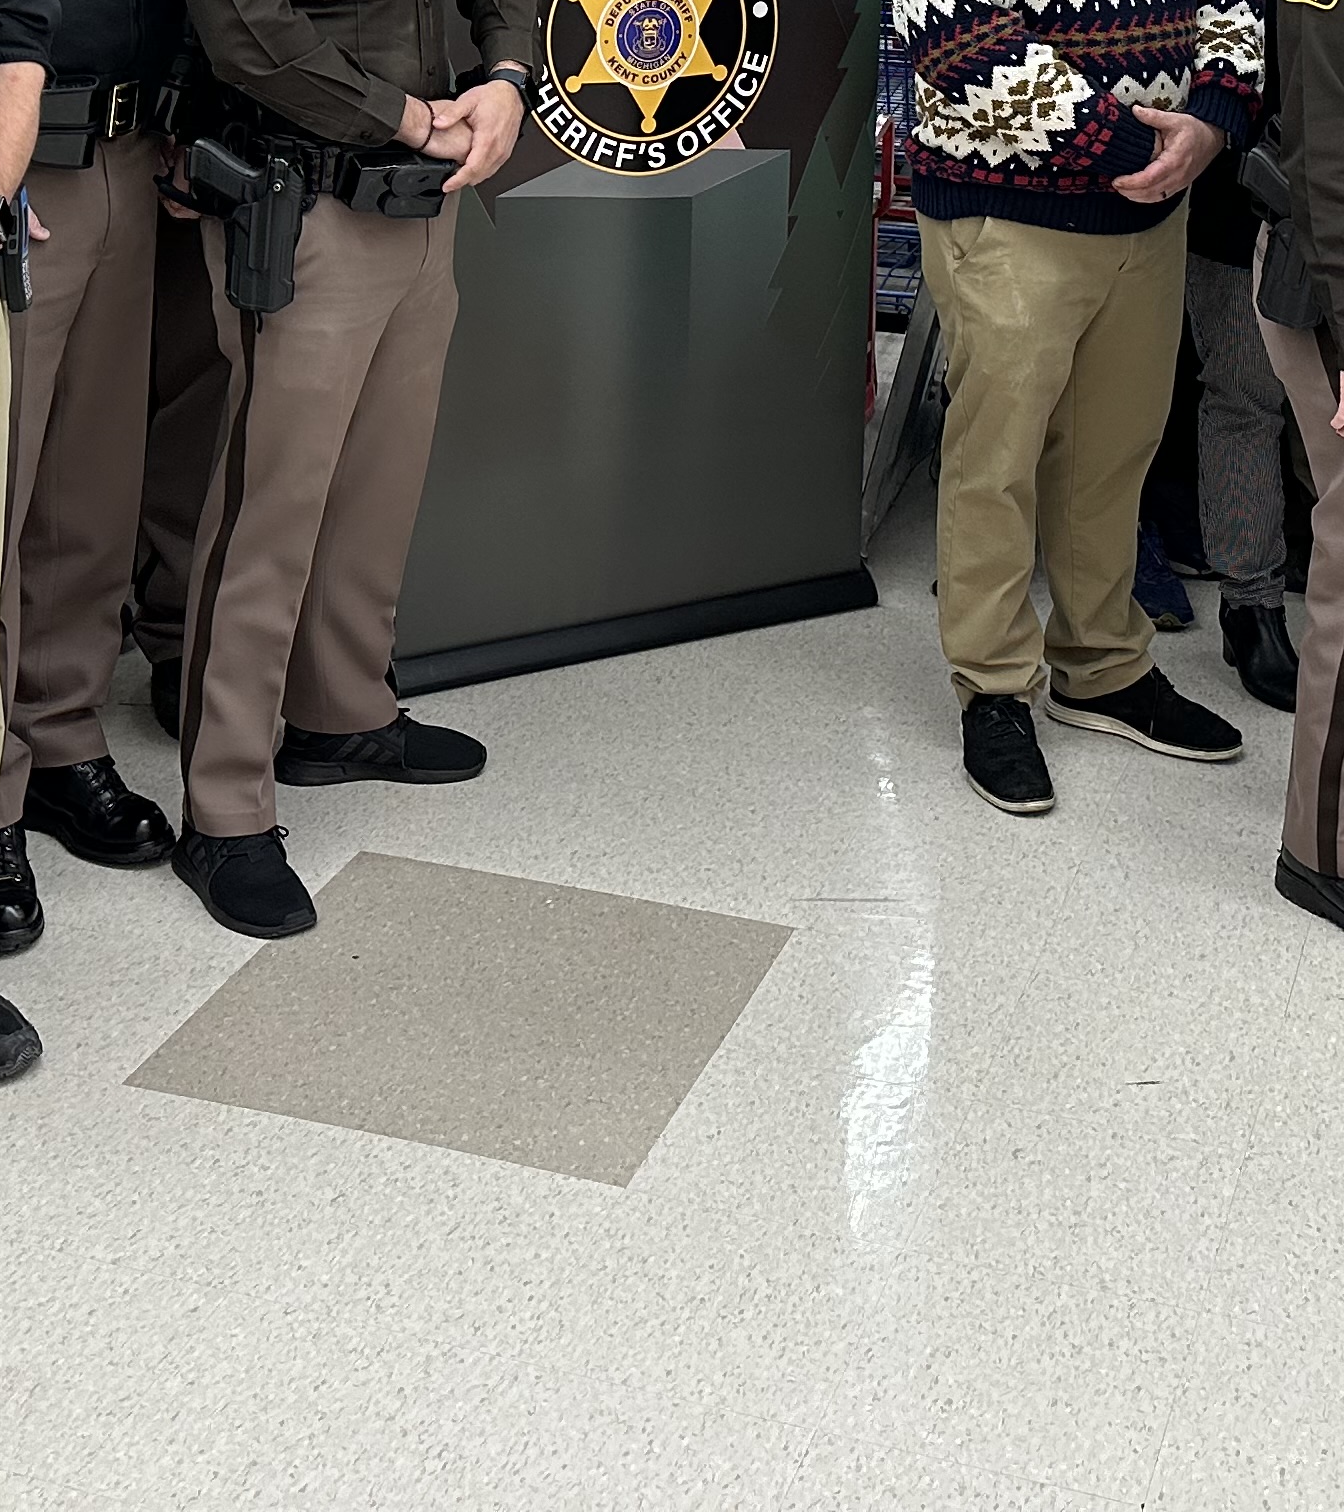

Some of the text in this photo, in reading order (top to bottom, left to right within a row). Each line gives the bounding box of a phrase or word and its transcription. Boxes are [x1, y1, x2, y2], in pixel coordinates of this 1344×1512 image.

[628, 0, 658, 16] STATE
[607, 51, 688, 85] KENT COUNTY
[626, 53, 672, 70] MICHIGAN
[677, 50, 770, 158] OFFICE
